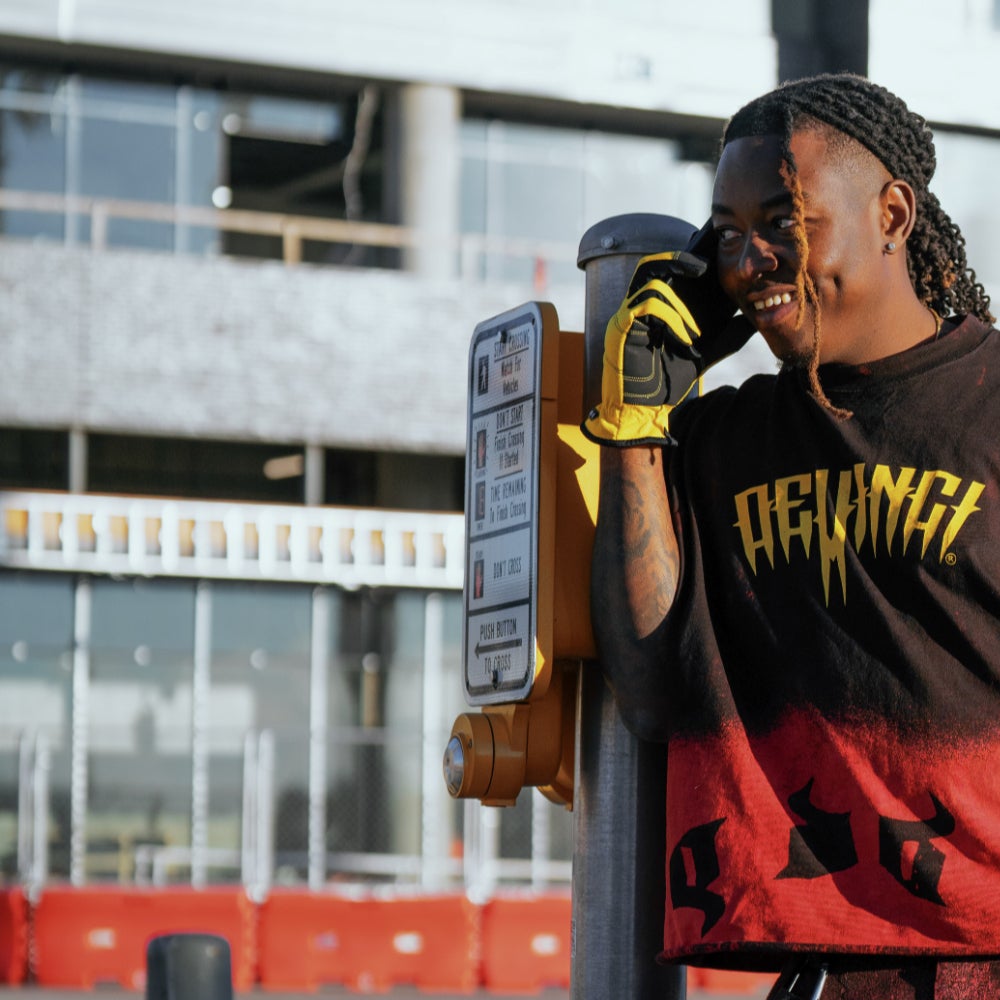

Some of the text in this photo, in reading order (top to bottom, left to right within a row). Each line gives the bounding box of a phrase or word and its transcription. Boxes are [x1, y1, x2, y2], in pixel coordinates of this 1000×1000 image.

[510, 404, 524, 425] START
[508, 429, 525, 449] Crossing
[490, 476, 527, 503] TIME REMAINING
[497, 503, 508, 522] Finish
[510, 499, 527, 520] Crossing
[508, 556, 522, 576] CROSS
[480, 617, 517, 641] PUSH BUTTON
[484, 653, 511, 675] TO CROSS
